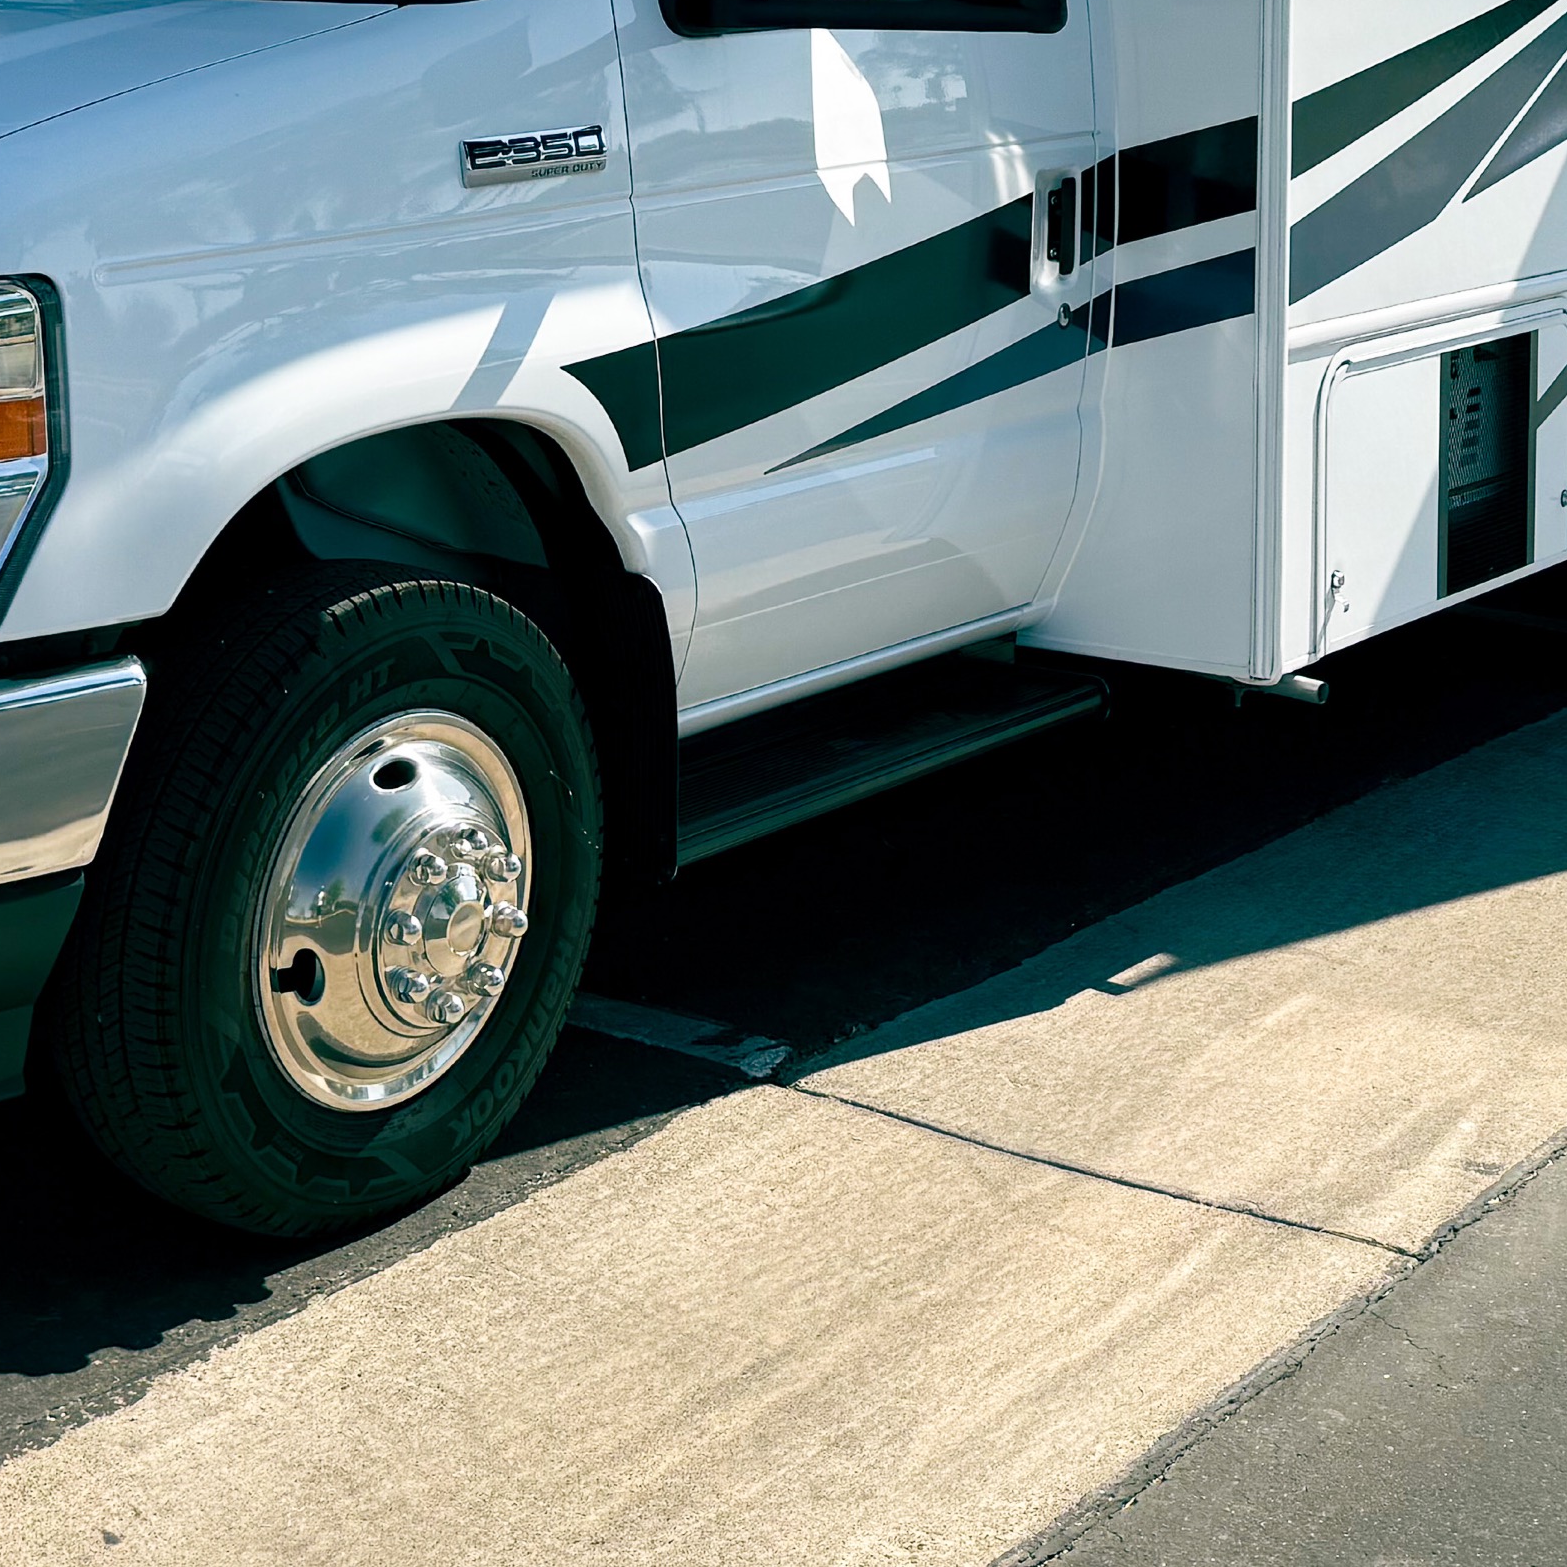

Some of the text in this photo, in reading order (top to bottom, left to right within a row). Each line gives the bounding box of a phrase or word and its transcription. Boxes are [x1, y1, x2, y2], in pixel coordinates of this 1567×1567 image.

[531, 161, 604, 178] SUPER DUTY
[347, 657, 396, 708] HT
